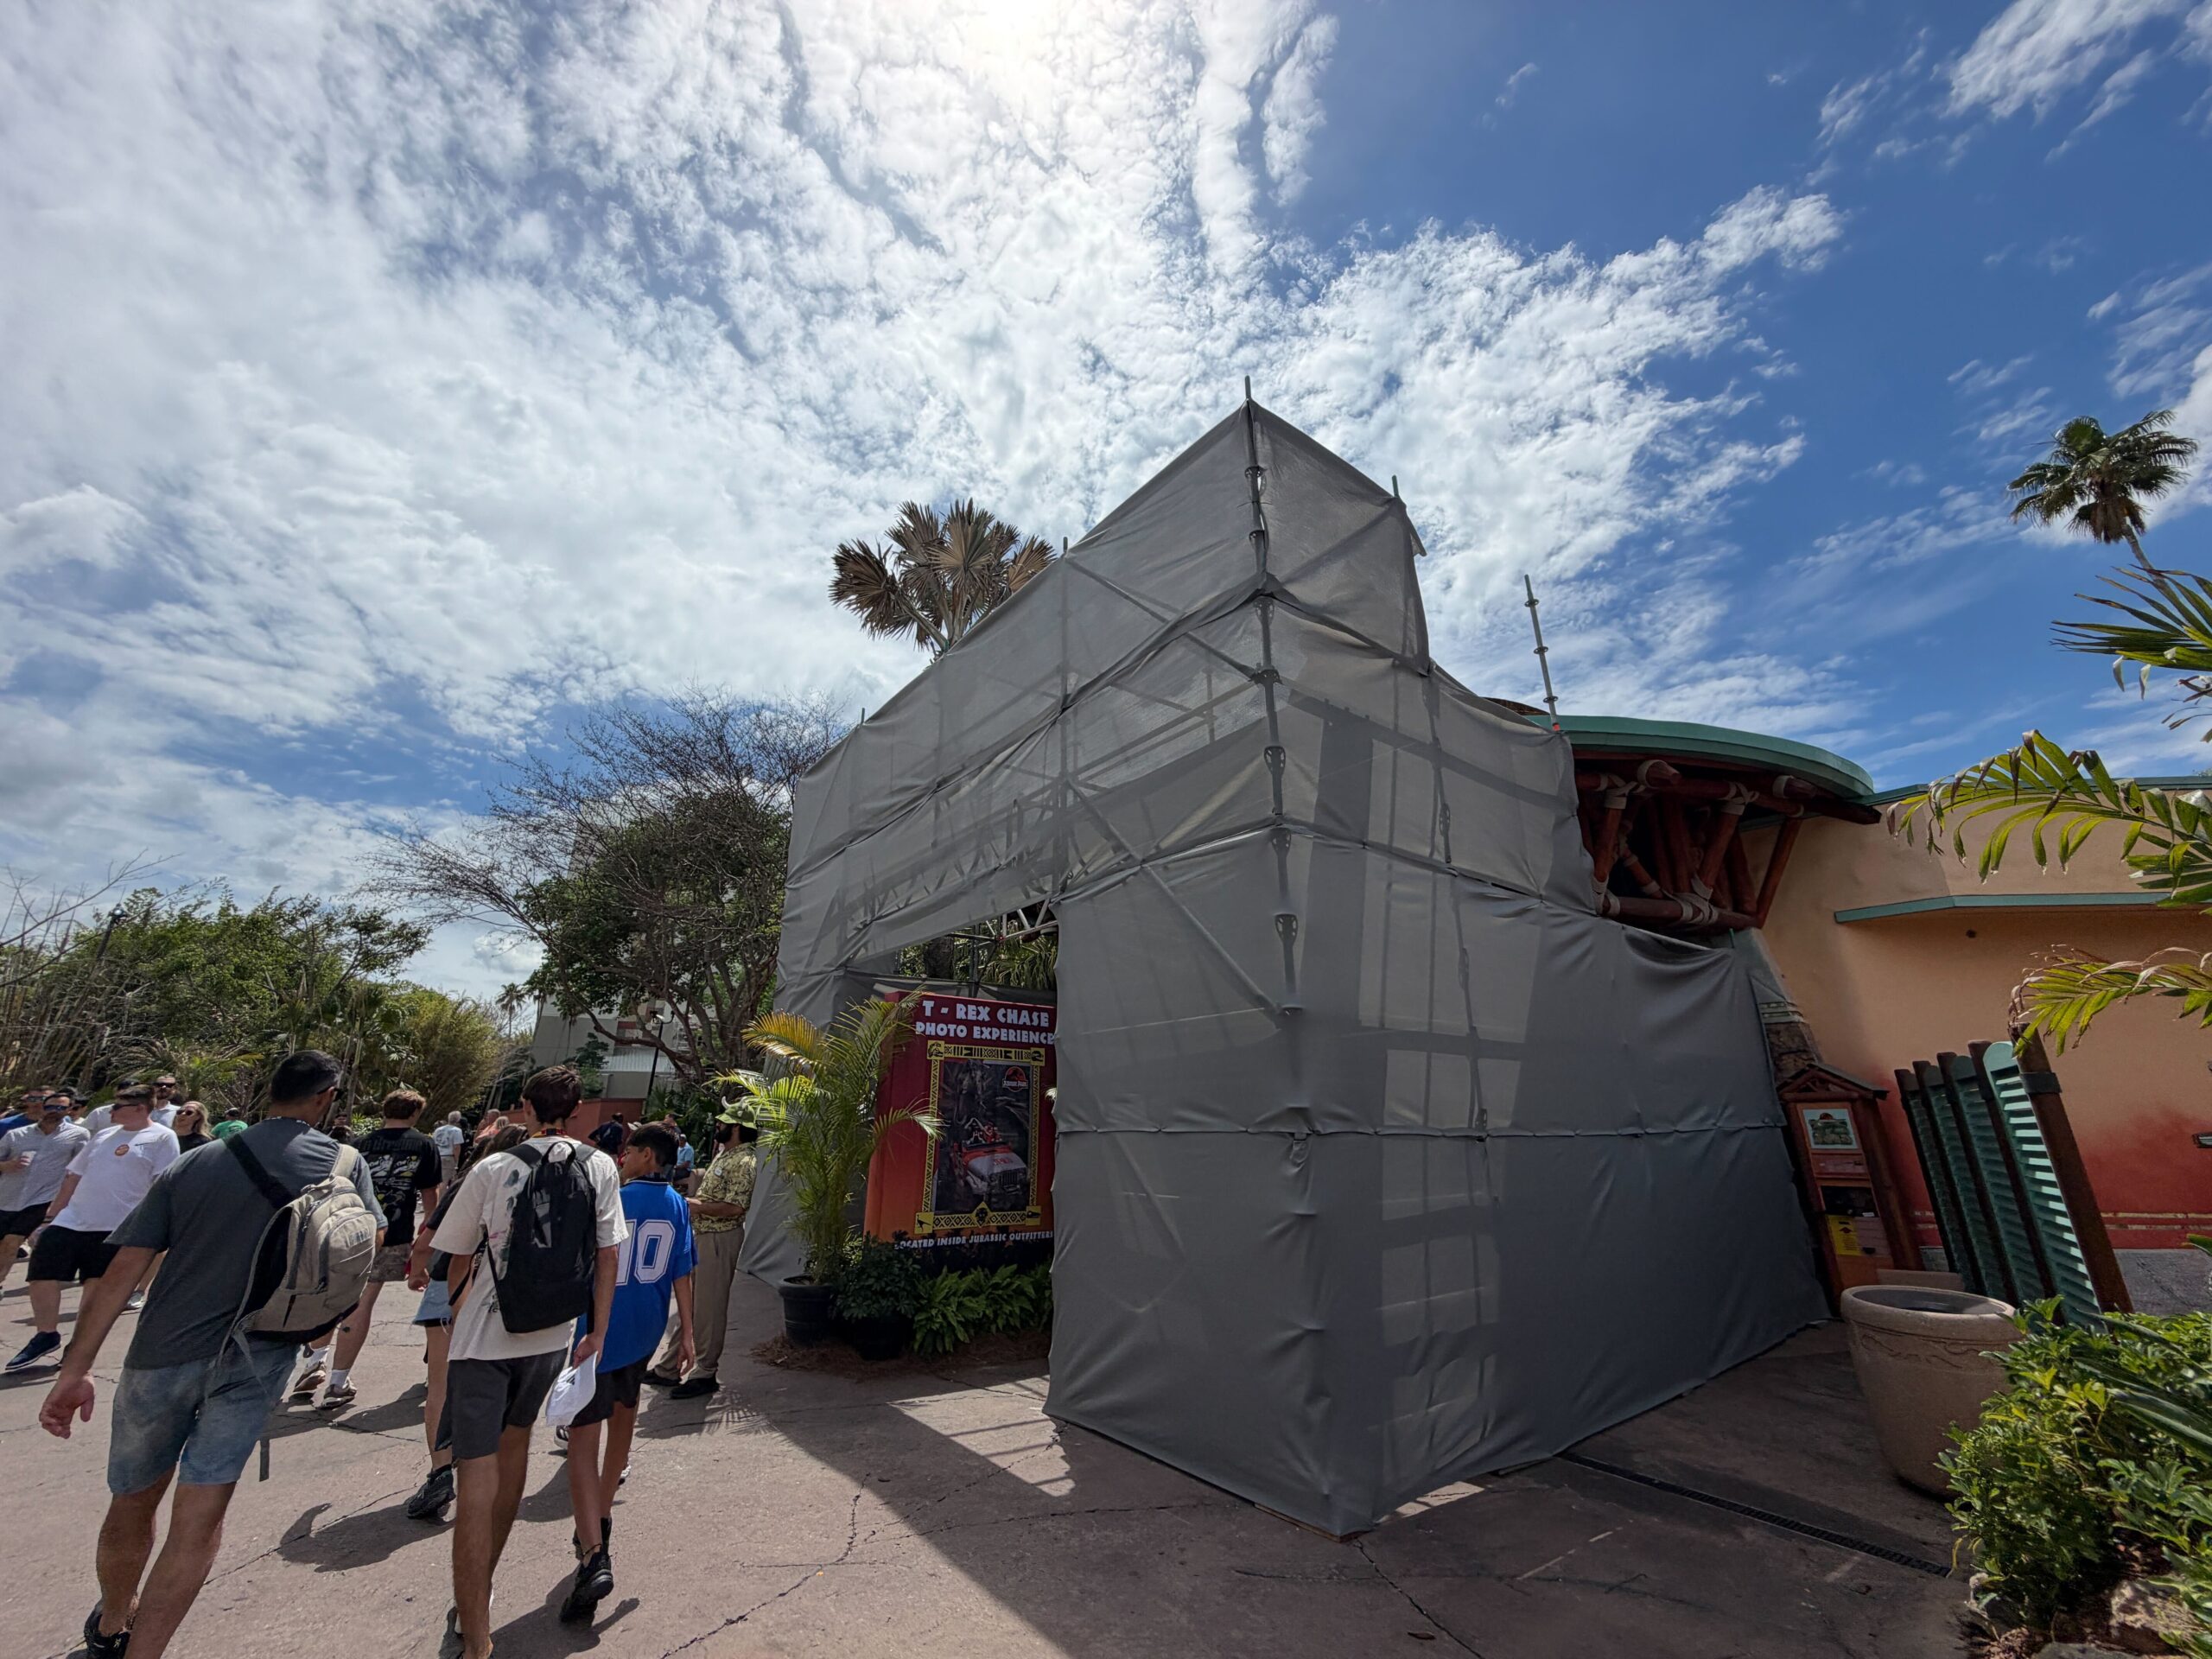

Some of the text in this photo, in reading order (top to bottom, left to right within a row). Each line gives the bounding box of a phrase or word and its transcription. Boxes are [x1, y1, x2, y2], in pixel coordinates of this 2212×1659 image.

[923, 1000, 935, 1017] T
[956, 1003, 991, 1022] REX
[996, 1007, 1050, 1027] CHASE
[915, 1021, 1055, 1045] PHOTO EXPERIENCE
[615, 1218, 676, 1286] 10
[937, 1236, 966, 1246] INSIDE
[969, 1233, 1007, 1243] JURASSIC
